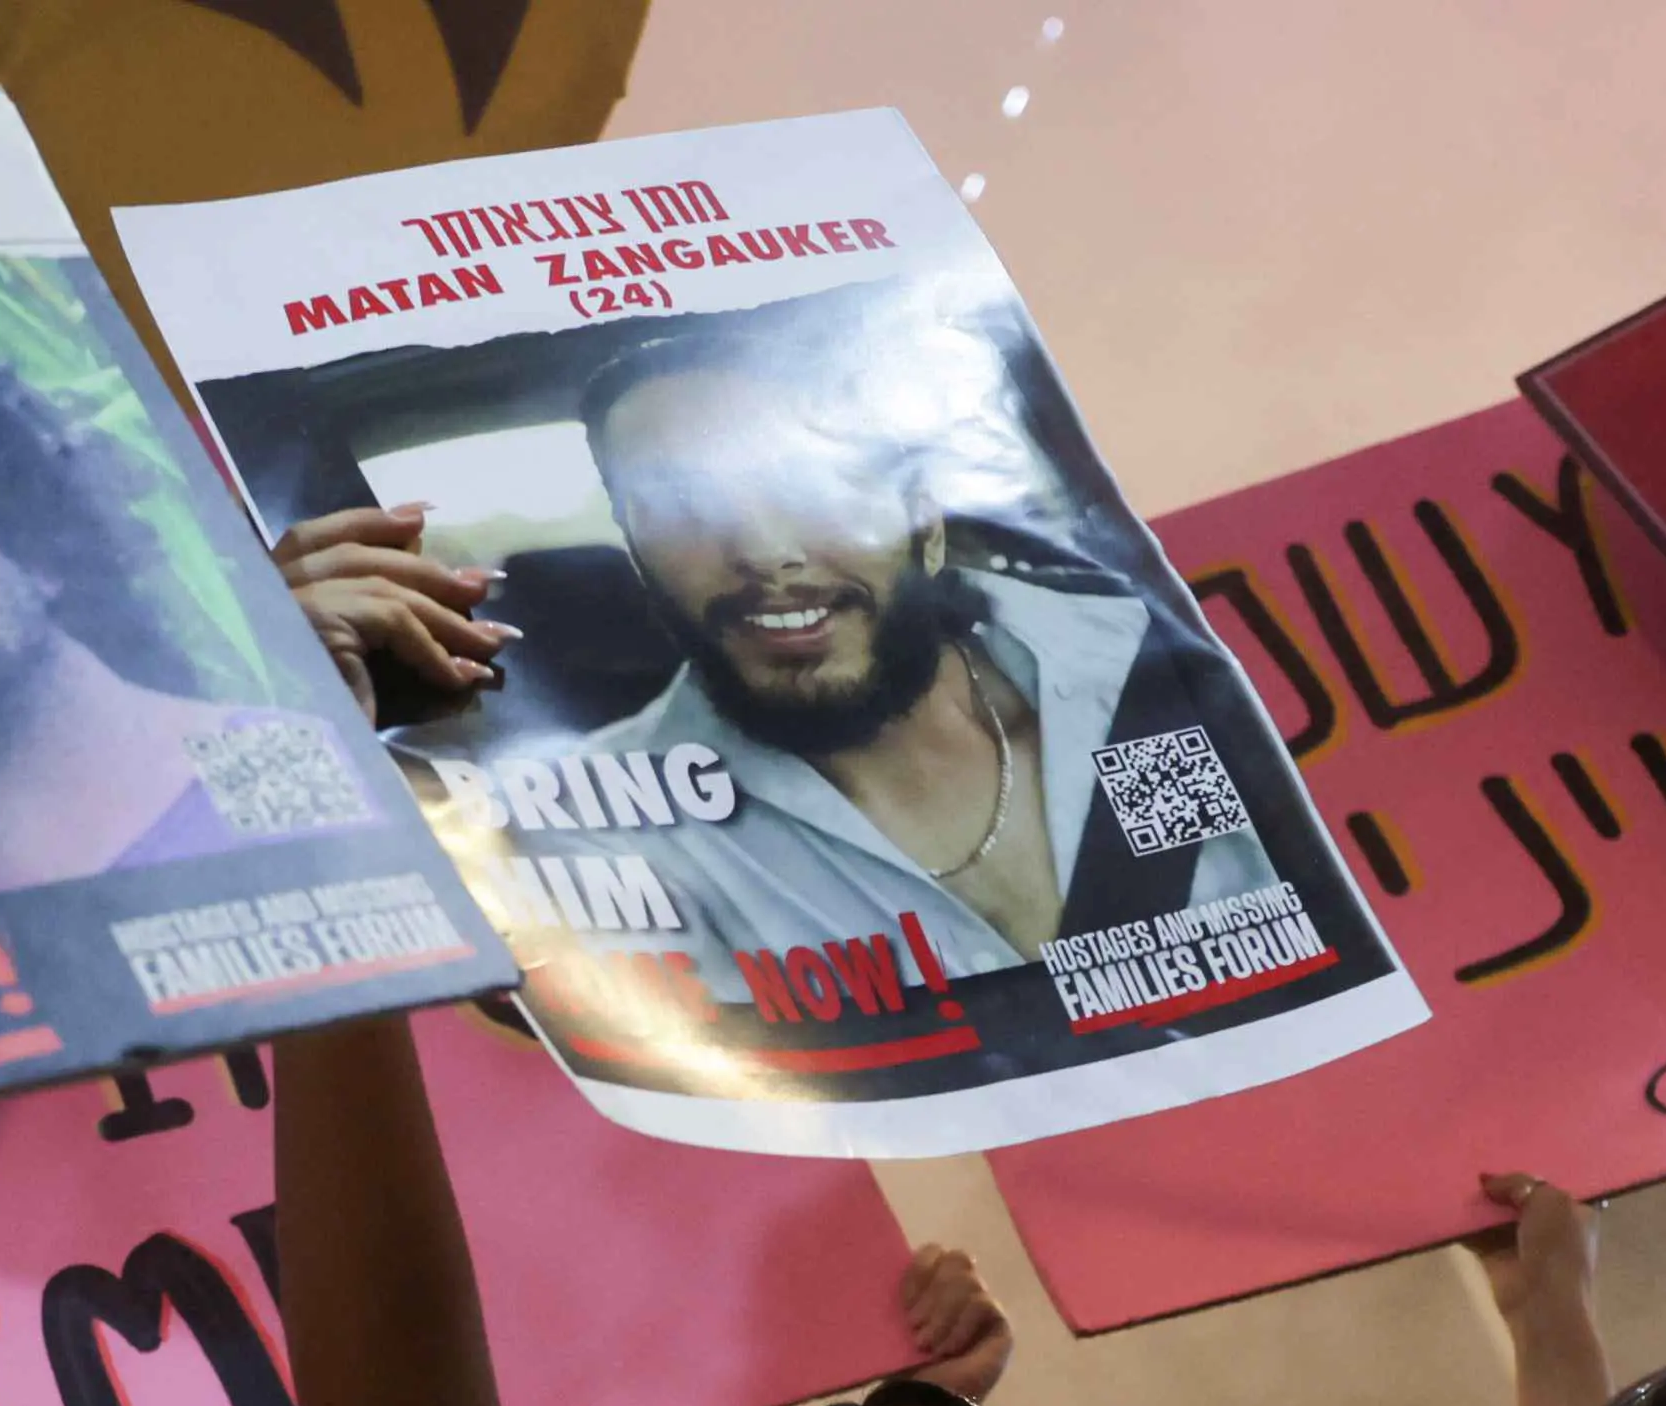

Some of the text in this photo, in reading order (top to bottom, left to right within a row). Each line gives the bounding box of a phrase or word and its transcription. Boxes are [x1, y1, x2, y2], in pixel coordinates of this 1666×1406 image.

[401, 179, 730, 259] מתן צנגאוקר
[283, 217, 899, 336] MATAN ZANGAUKER
[568, 279, 673, 318] (24)
[431, 742, 737, 831] BRING
[133, 903, 465, 1003] FAMILIES FORUM
[734, 911, 965, 1024] NOW!
[1039, 881, 1303, 976] HOSTAGES AND MISSING
[1053, 911, 1327, 1022] FAMILIES FORUM
